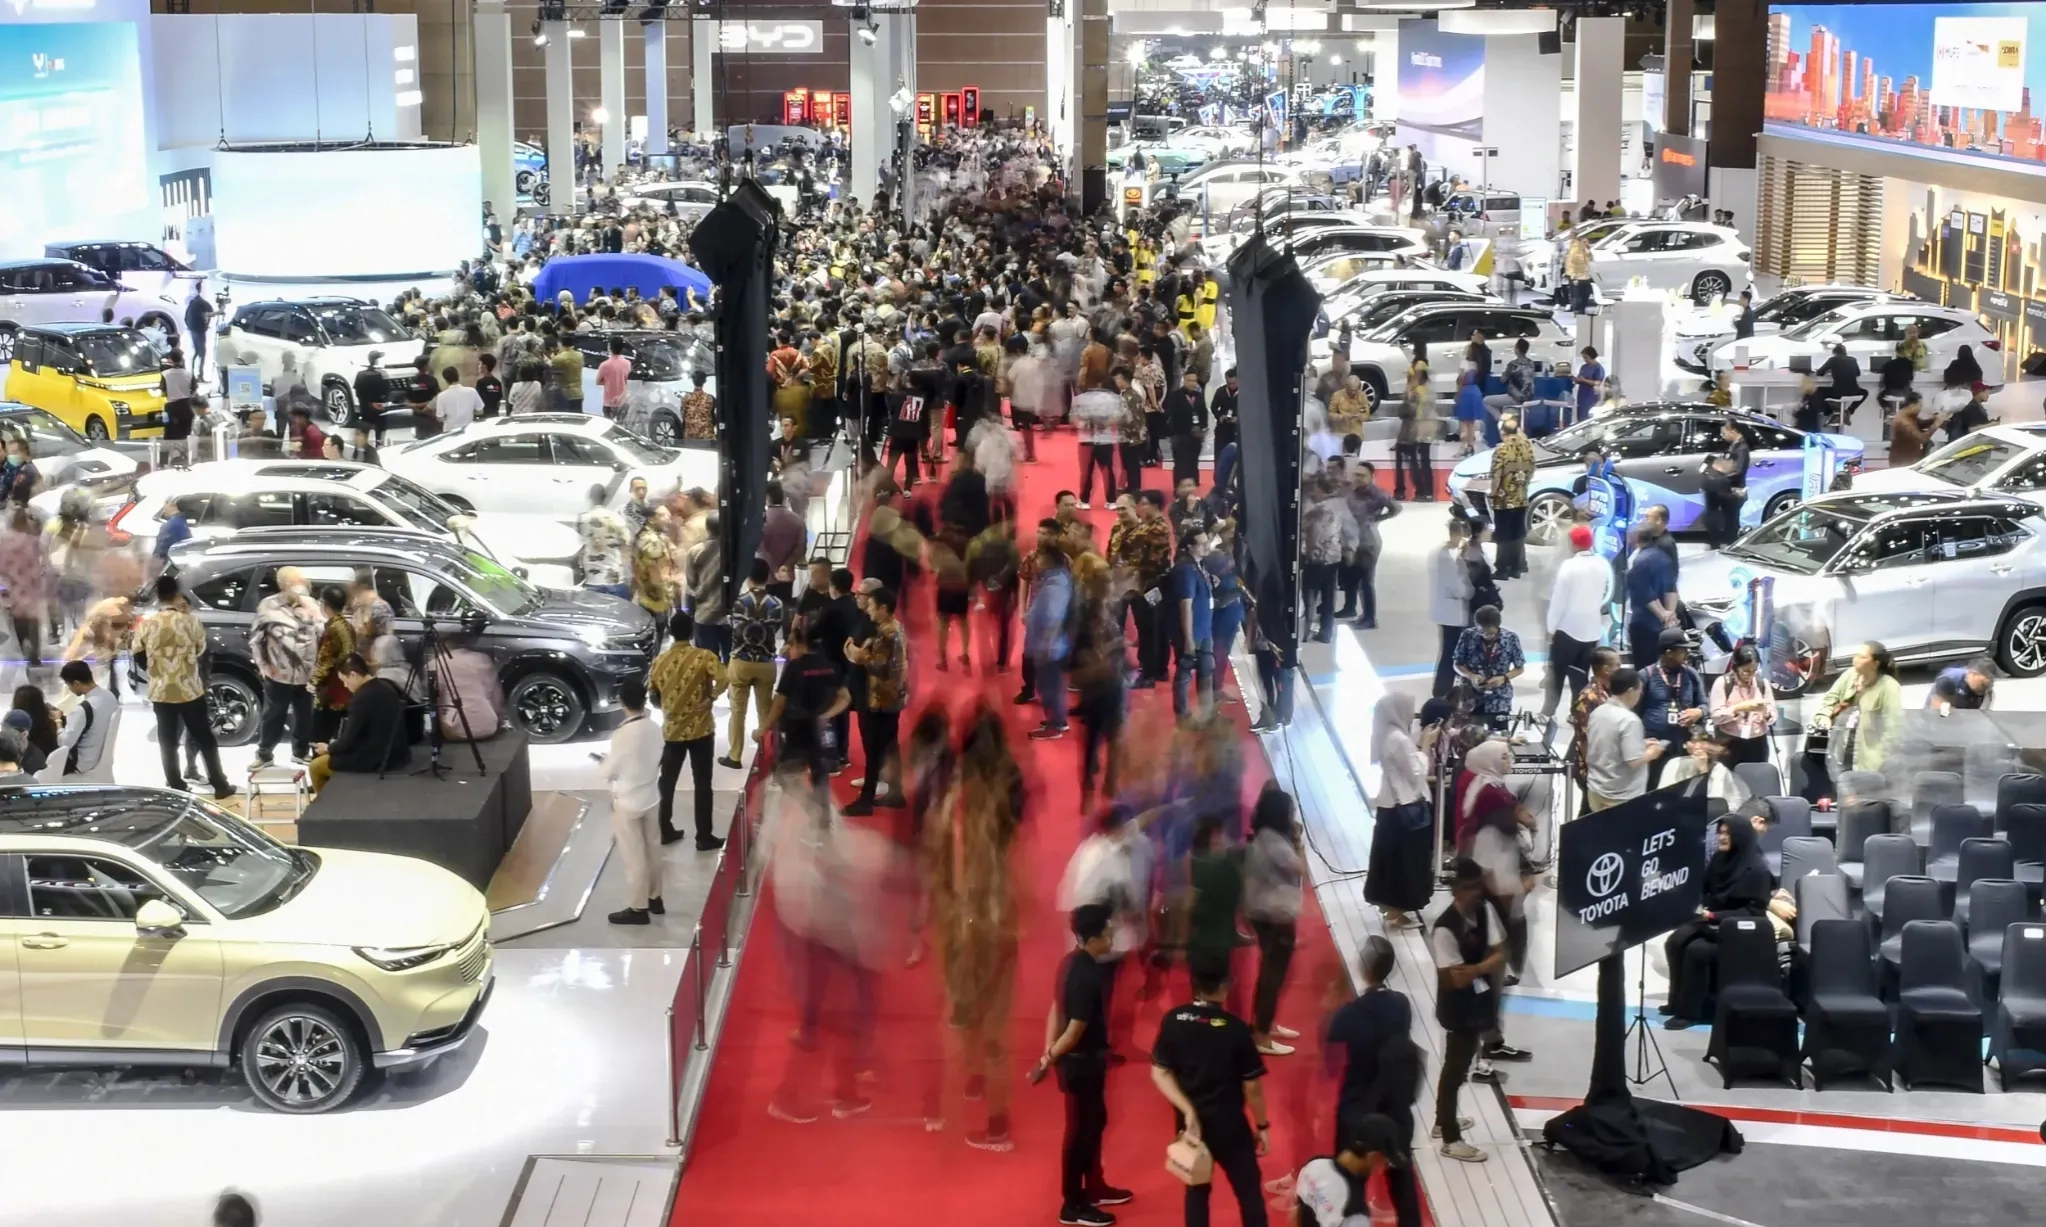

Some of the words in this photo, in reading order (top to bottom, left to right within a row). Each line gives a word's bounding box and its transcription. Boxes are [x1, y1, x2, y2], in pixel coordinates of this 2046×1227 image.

[1642, 828, 1676, 856] LET'S
[1641, 857, 1659, 878] GO
[1640, 867, 1689, 900] BEYOND
[1579, 892, 1629, 924] TOYOTA
